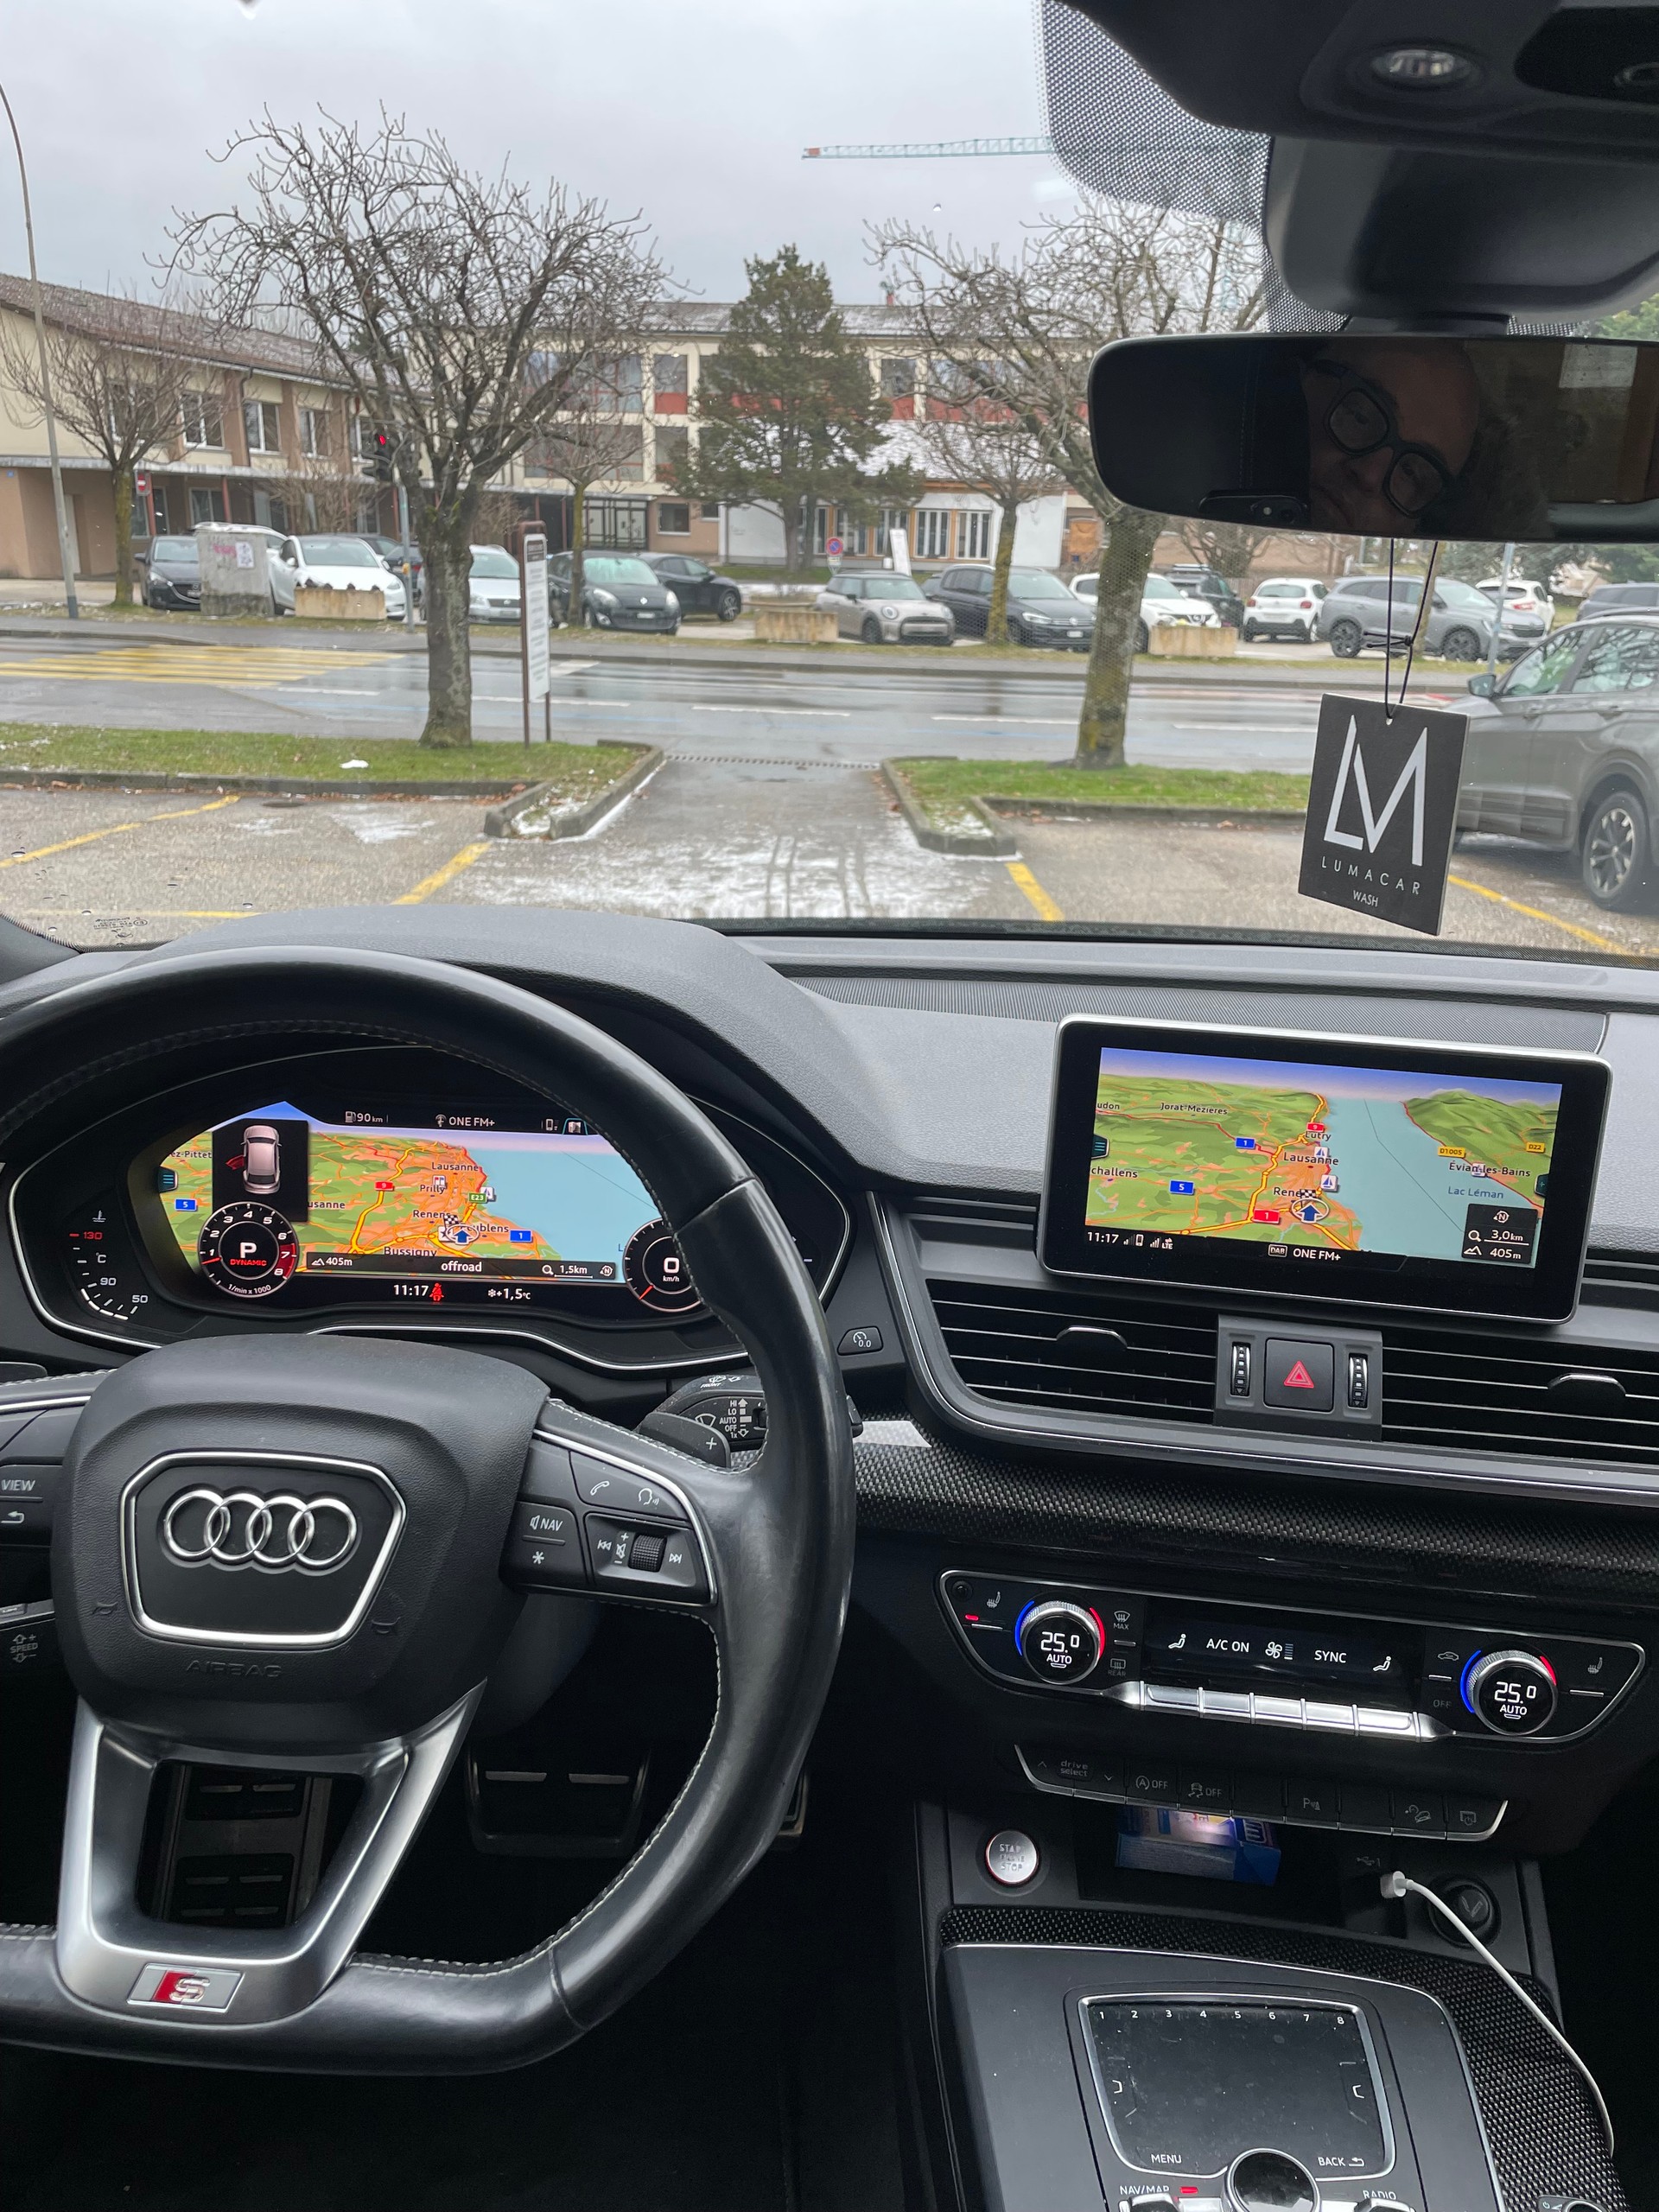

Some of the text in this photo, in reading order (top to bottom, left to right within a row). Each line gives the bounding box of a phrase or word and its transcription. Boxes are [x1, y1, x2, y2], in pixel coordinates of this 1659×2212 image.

[1321, 855, 1421, 895] LUMACAR
[1353, 890, 1379, 908] WASH
[448, 1116, 495, 1127] ONE FM+
[1305, 1131, 1332, 1141] Lutry
[1283, 1152, 1339, 1166] Lausanne
[431, 1162, 480, 1173] Lausanne
[1090, 1166, 1138, 1179] challens
[420, 1185, 445, 1195] Prilly
[1448, 1185, 1504, 1199] Lac Léman
[308, 1200, 346, 1210] usanne
[84, 1231, 103, 1240] 130
[1087, 1231, 1120, 1244] 11:17
[239, 1243, 257, 1258] P
[1293, 1249, 1316, 1259] ONE
[1319, 1250, 1341, 1262] FM+
[326, 1257, 353, 1267] 405m
[441, 1262, 482, 1272] offroad
[664, 1257, 680, 1274] 0
[560, 1265, 588, 1275] 1,5km
[100, 1277, 117, 1286] 90
[228, 1284, 247, 1294] 1/min
[254, 1284, 271, 1294] 1000
[393, 1284, 429, 1297] 11:17
[132, 1294, 149, 1304] 50
[719, 1416, 737, 1425] AUTO
[1, 1479, 36, 1491] VIEW
[540, 1518, 563, 1531] NAV
[10, 1643, 39, 1654] SPEED
[1205, 1638, 1249, 1653] A/C ON
[1046, 1653, 1072, 1664] AUTO
[1313, 1649, 1347, 1663] SYNC
[1433, 1699, 1452, 1709] OFF
[1499, 1704, 1528, 1716] AUTO
[1060, 1760, 1089, 1770] drive
[1060, 1768, 1089, 1777] select
[1151, 1780, 1168, 1790] OFF
[1205, 1788, 1223, 1798] OFF
[1001, 1862, 1023, 1872] STOP
[1131, 2010, 1139, 2018] 2
[1166, 2009, 1173, 2018] 3
[1234, 2011, 1242, 2019] 5
[1268, 2012, 1276, 2020] 6
[1337, 2016, 1344, 2024] 8
[1151, 2153, 1182, 2164] MENU
[1318, 2157, 1345, 2167] BACK
[1119, 2185, 1170, 2196] NAV/MAP
[1363, 2190, 1397, 2201] RADIO
